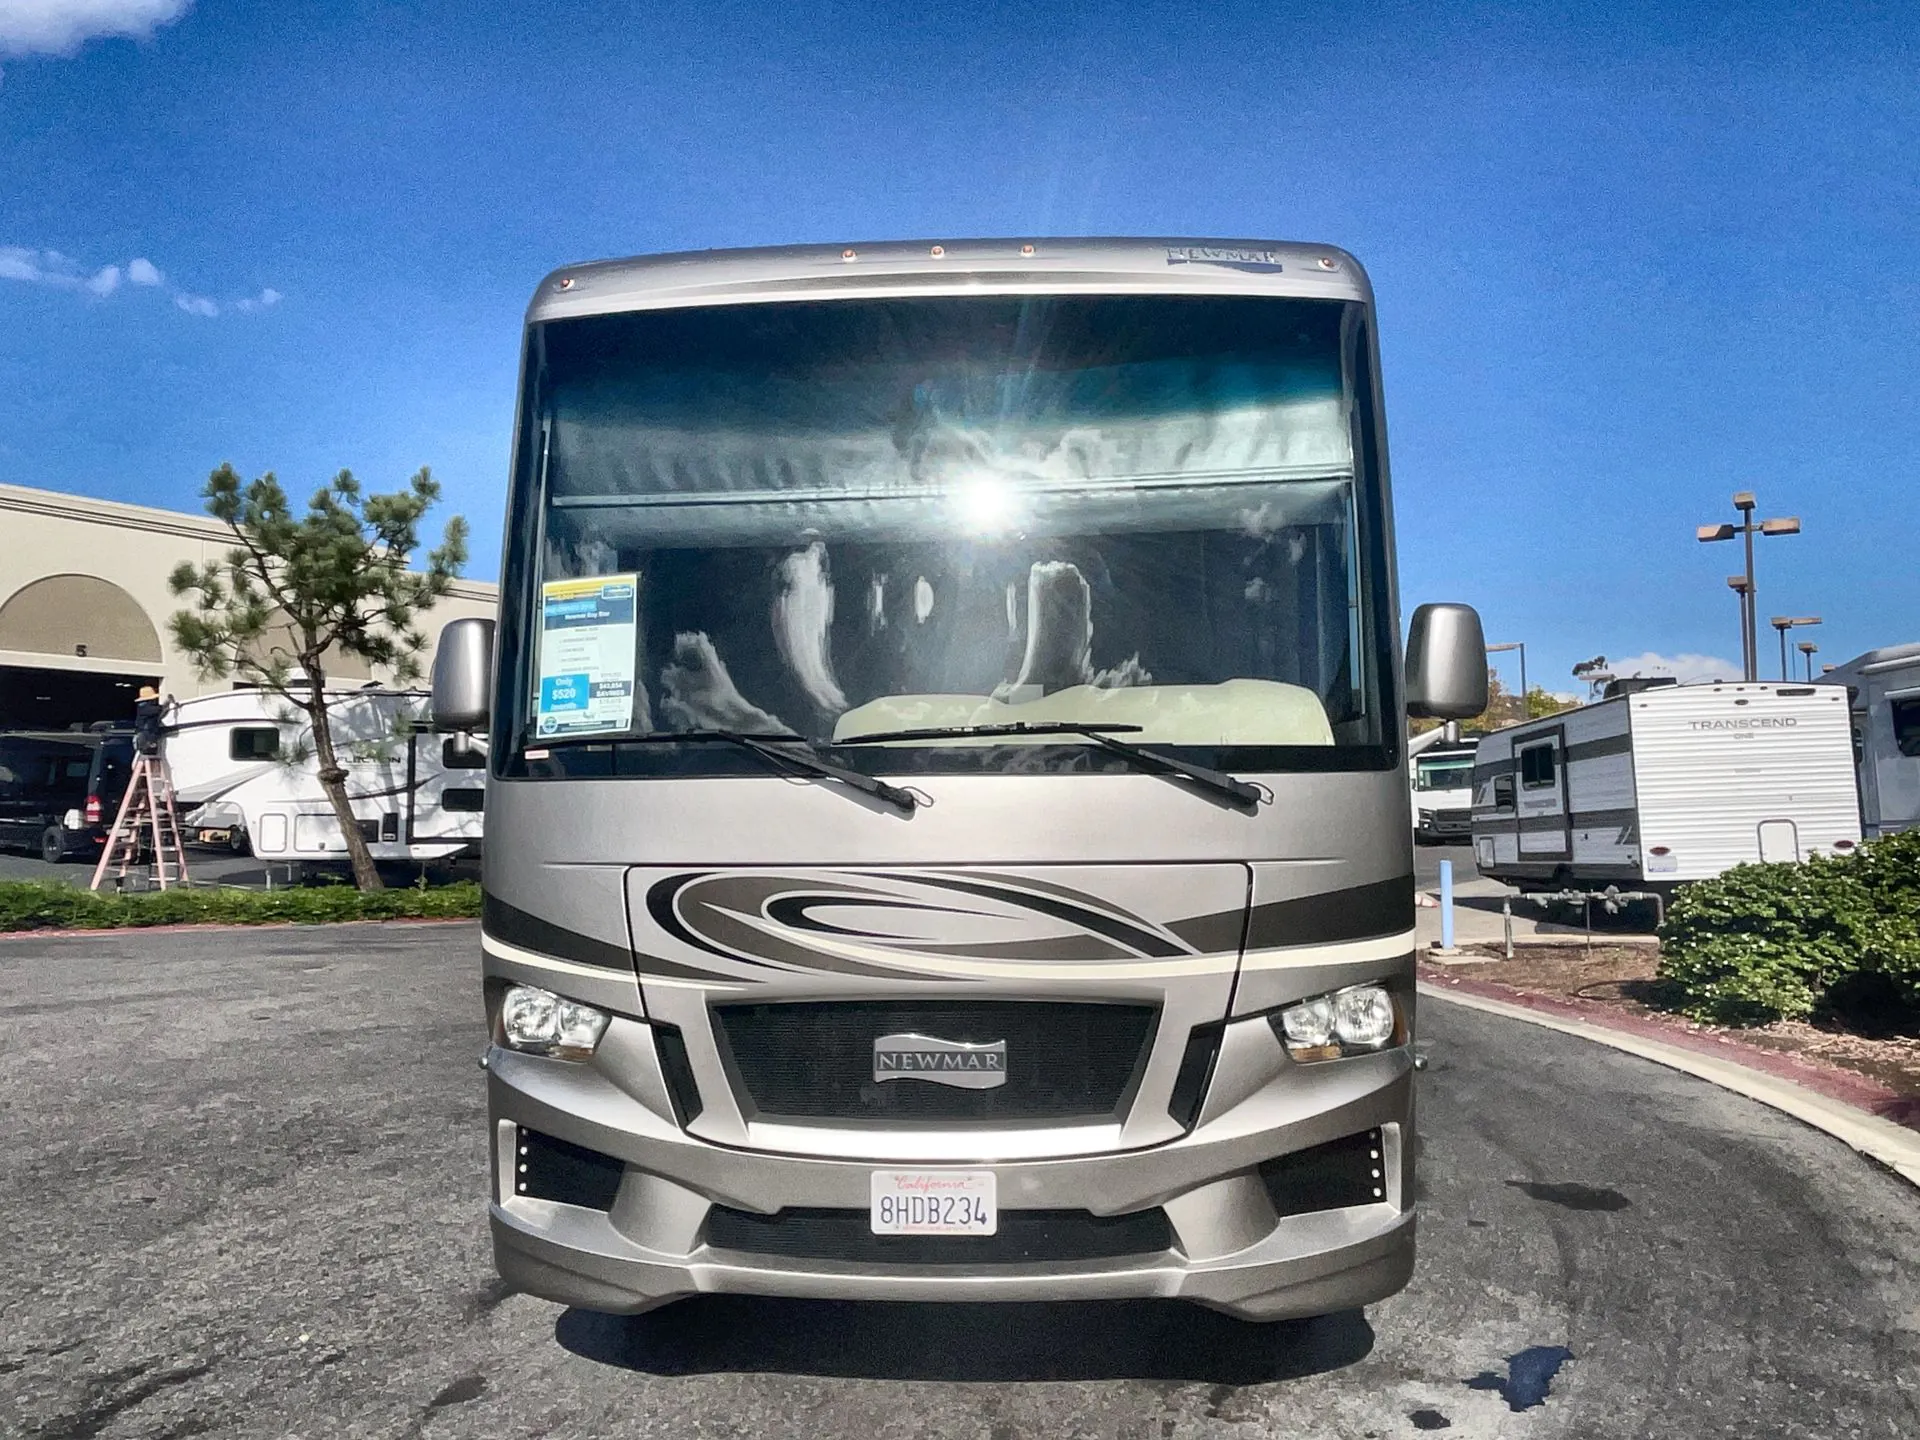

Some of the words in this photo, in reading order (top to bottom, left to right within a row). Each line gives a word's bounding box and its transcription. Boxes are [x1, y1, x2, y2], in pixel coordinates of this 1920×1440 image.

[76, 645, 87, 657] 5
[555, 678, 574, 687] Only
[552, 688, 576, 700] $520
[1688, 717, 1798, 731] TRANSCEND
[878, 1053, 1002, 1070] NEWMAR
[895, 1175, 969, 1193] California
[880, 1196, 988, 1225] 8HDB234
